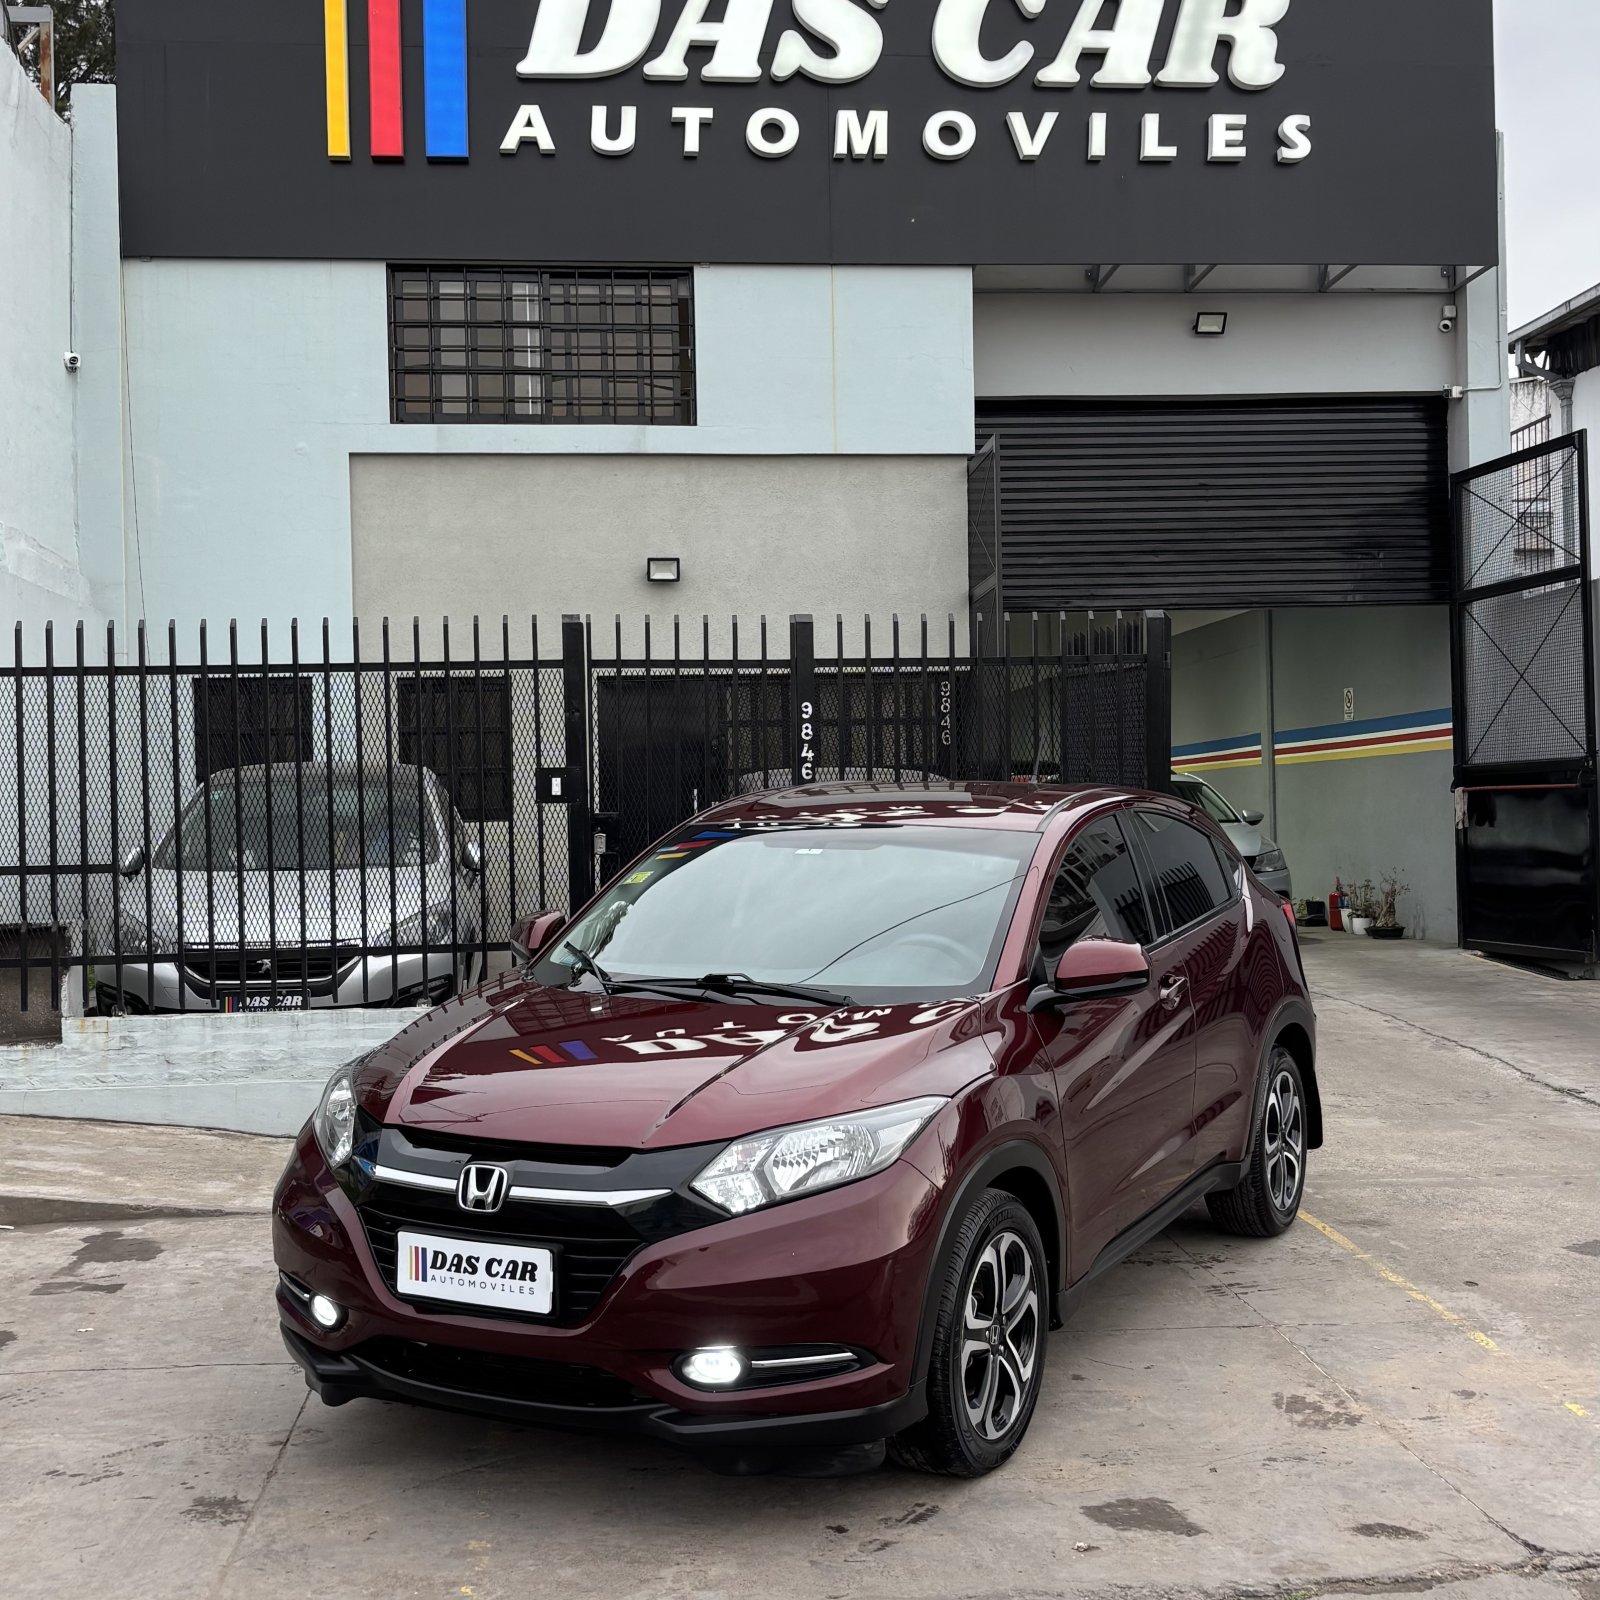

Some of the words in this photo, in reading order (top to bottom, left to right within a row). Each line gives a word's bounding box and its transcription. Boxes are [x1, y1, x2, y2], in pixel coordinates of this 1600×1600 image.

[515, 0, 884, 84] DAS
[932, 0, 1286, 91] CAR
[500, 104, 1312, 163] AUTOMOVILES
[801, 701, 814, 780] 9846
[430, 1250, 480, 1275] DAS
[485, 1258, 538, 1282] CAR
[430, 1274, 535, 1295] AUTOMOVILES
